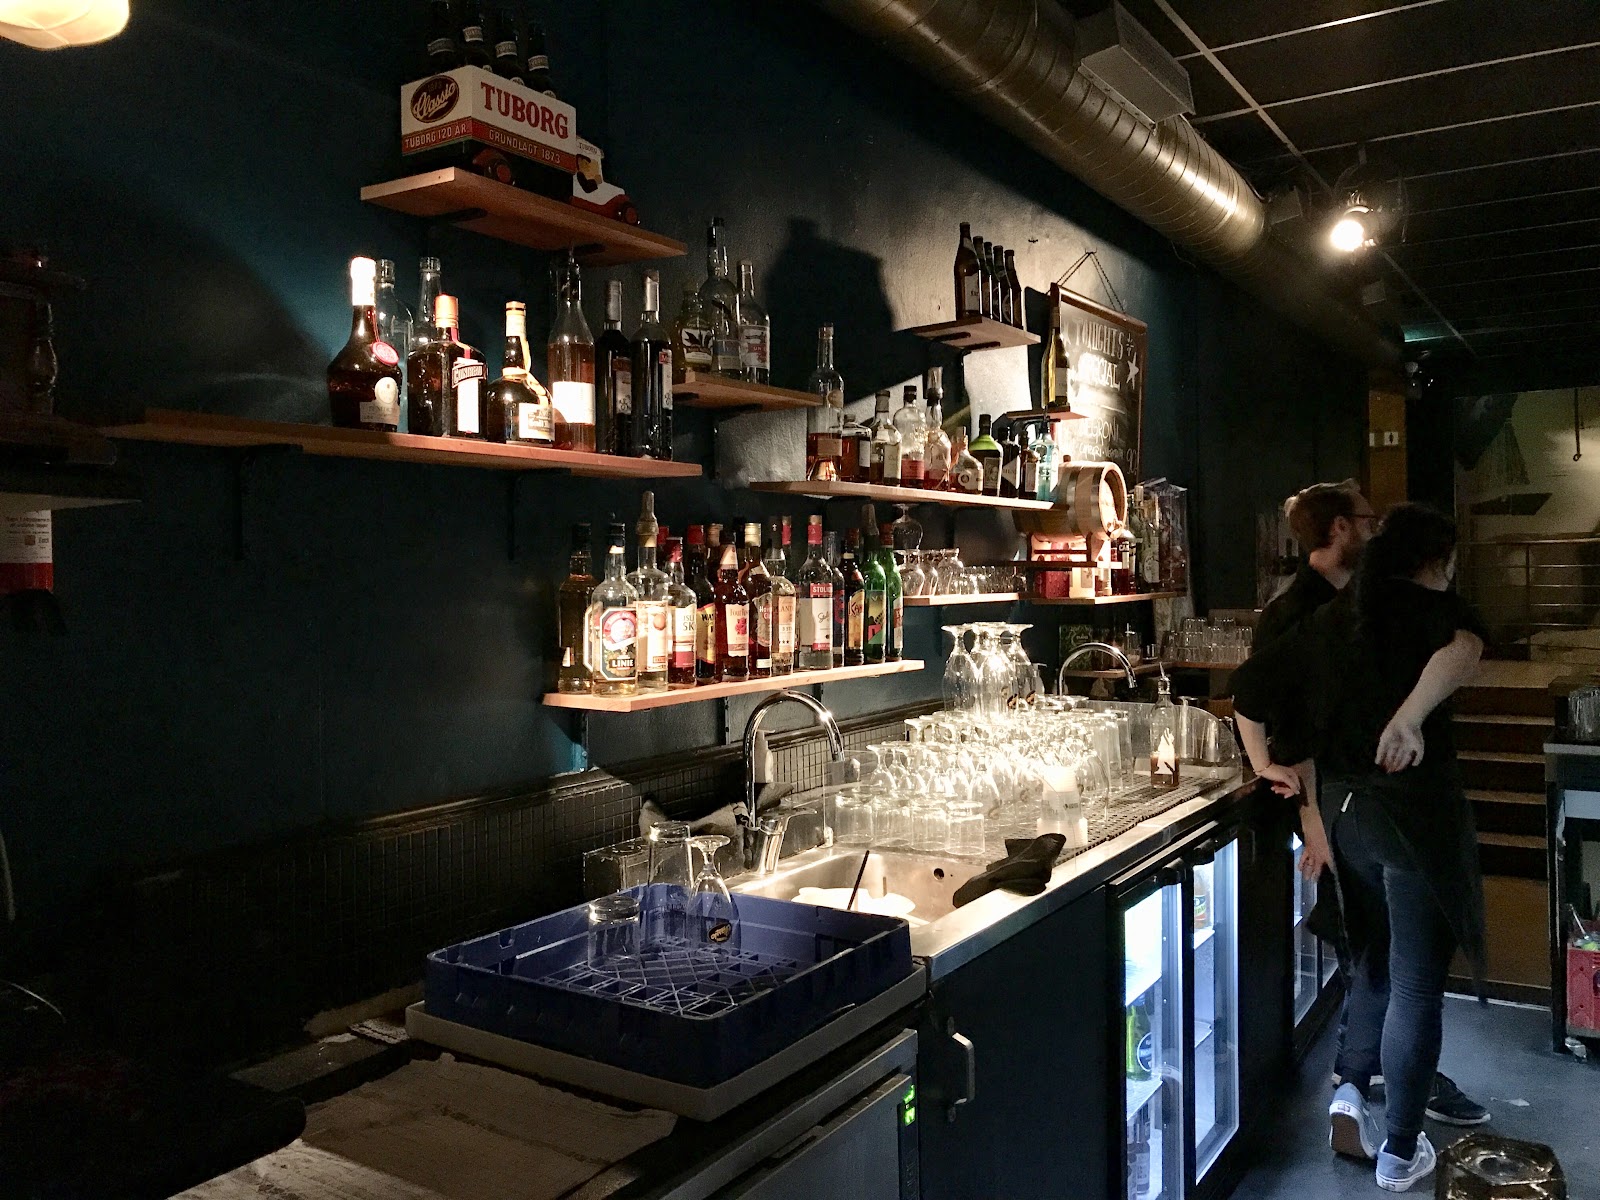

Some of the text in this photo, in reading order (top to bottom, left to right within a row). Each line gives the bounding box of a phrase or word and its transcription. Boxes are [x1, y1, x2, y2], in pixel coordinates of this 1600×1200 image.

[480, 81, 569, 139] TUBORG
[405, 131, 436, 148] TUBORG
[438, 126, 452, 140] 120
[489, 129, 561, 164] GRUNDLAGT 1873
[611, 659, 634, 667] LINIE
